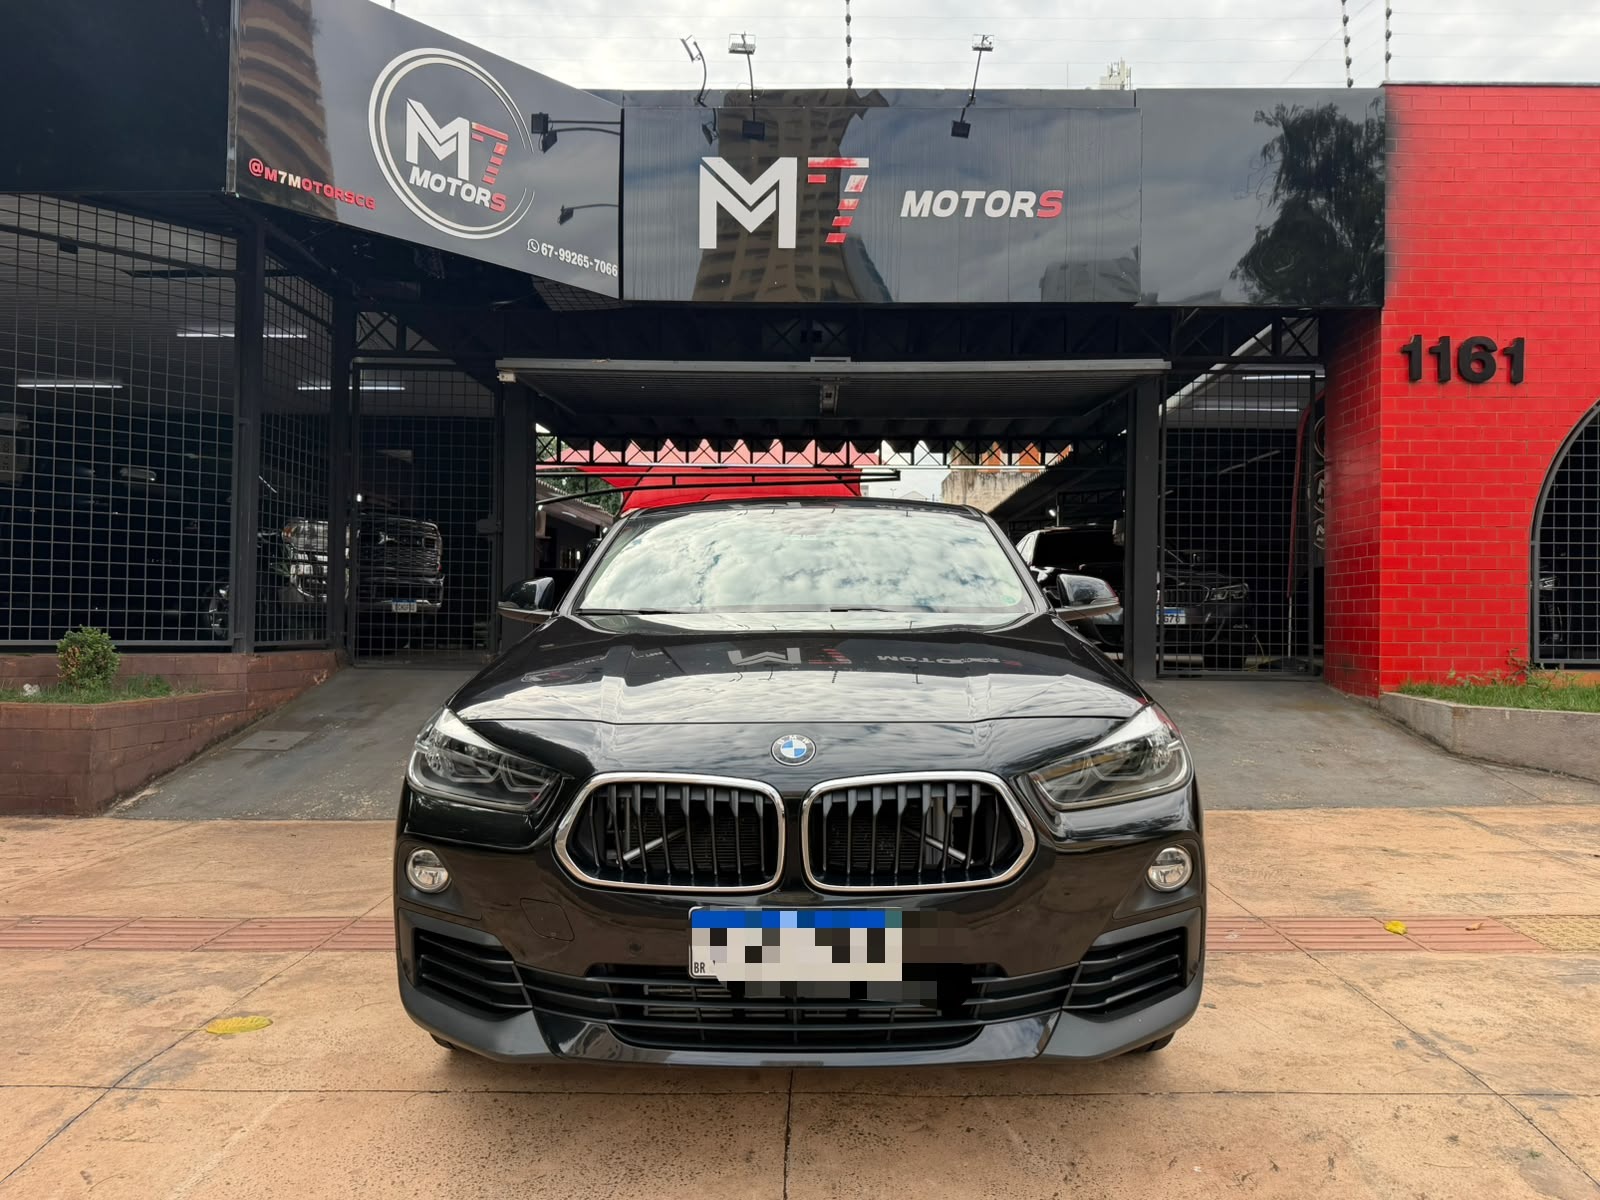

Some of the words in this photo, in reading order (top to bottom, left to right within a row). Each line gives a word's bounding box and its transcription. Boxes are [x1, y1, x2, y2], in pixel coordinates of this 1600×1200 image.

[405, 97, 509, 185] M7
[248, 157, 376, 210] @M7MOTORSCG
[409, 165, 507, 213] MOTORS
[699, 156, 870, 250] M7
[900, 189, 1064, 219] MOTORS
[540, 242, 618, 277] 67-99265-7066
[1400, 333, 1526, 386] 1161
[693, 961, 706, 974] BR
